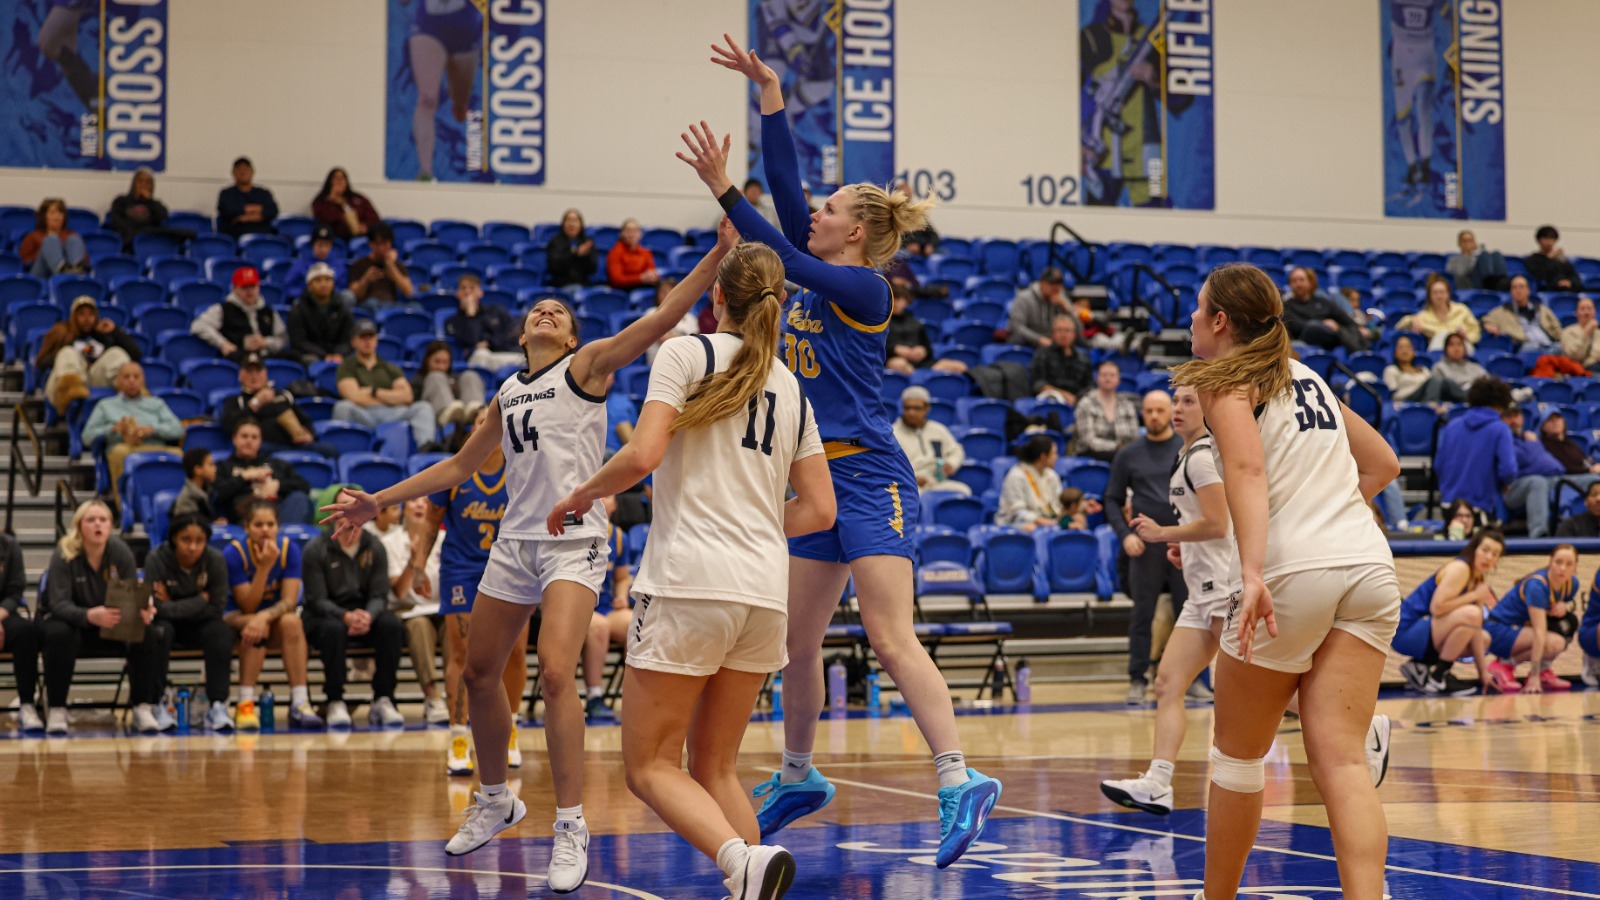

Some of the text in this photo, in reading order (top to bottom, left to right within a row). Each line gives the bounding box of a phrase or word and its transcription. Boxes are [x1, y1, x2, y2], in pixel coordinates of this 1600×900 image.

[107, 16, 163, 161] CROSS
[1460, 0, 1502, 124] SKIING
[490, 35, 543, 175] CROSS
[843, 76, 892, 142] ICE
[1021, 174, 1078, 206] 102
[784, 332, 821, 379] 30
[506, 408, 539, 454] 14
[741, 389, 777, 456] 11
[1291, 378, 1337, 432] 33
[461, 501, 506, 520] Alask
